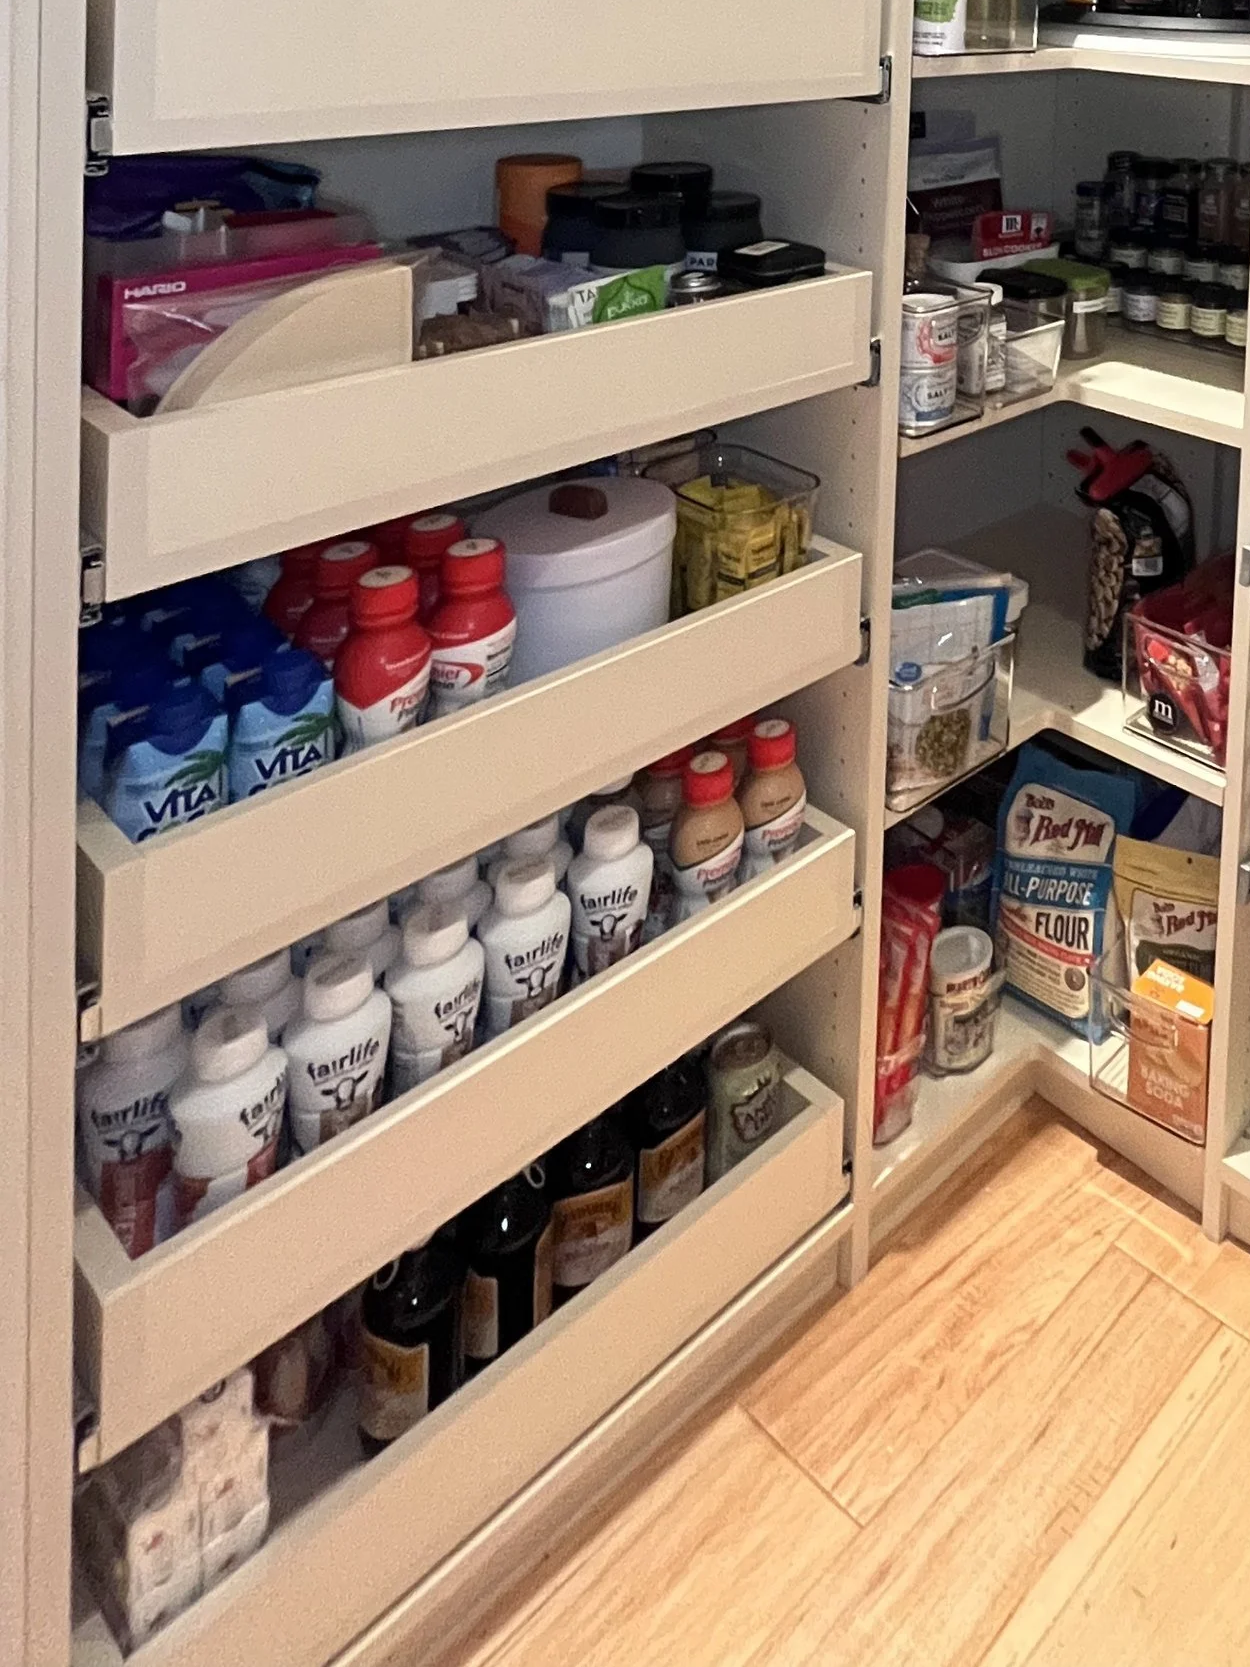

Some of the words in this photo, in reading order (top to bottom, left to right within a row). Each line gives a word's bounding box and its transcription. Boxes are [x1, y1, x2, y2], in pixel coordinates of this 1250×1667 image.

[124, 281, 187, 300] HARIO
[255, 744, 323, 780] VITA
[144, 783, 216, 824] VITA
[1030, 814, 1070, 846] Red
[1067, 817, 1109, 851] Mill
[580, 885, 639, 911] fairlife
[1035, 911, 1090, 950] FLOUR
[1165, 910, 1197, 937] Red
[504, 932, 564, 971] fairlife
[307, 1037, 380, 1082] fairlife
[1145, 1081, 1184, 1109] SODA
